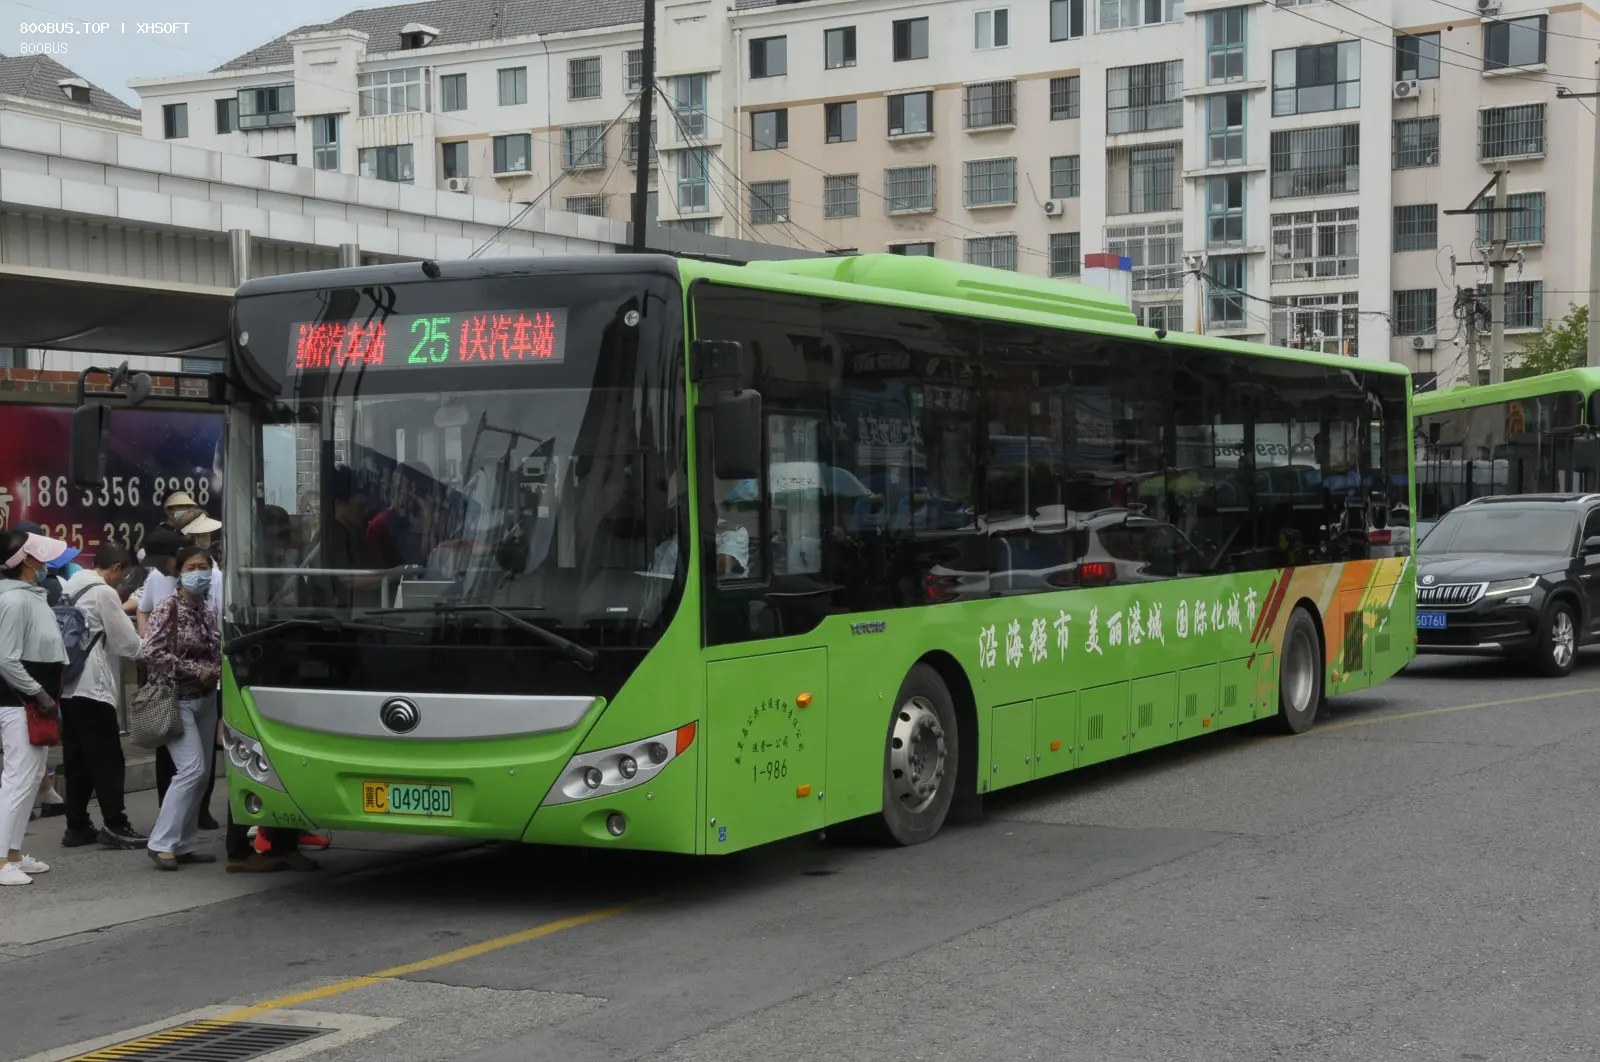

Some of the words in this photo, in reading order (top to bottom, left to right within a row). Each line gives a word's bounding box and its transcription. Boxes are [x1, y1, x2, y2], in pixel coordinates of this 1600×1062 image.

[408, 317, 450, 363] 25
[21, 476, 68, 507] 186
[979, 609, 1072, 669] 沿海强市
[1085, 600, 1165, 656] 美丽港城
[1176, 587, 1258, 639] 国际化城市
[752, 758, 788, 783] 1-986
[392, 787, 451, 812] 04908D
